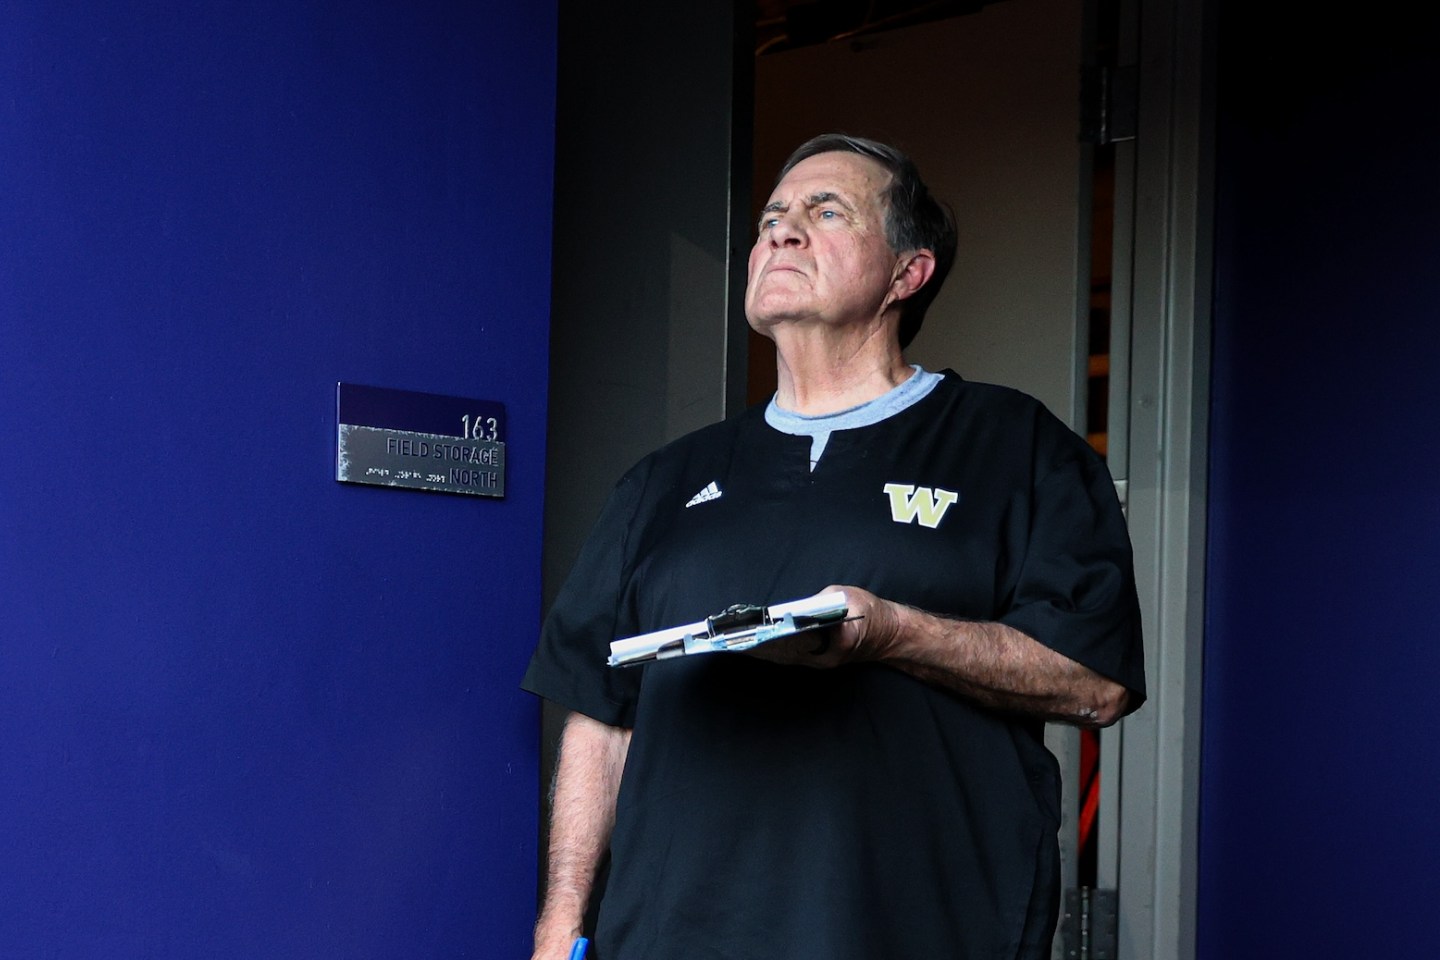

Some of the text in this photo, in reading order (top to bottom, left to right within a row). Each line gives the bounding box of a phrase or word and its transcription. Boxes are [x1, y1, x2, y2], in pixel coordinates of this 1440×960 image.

[462, 414, 498, 442] 163
[387, 437, 499, 467] FIELD STORAGE
[449, 467, 498, 488] NORTH
[883, 483, 958, 528] W
